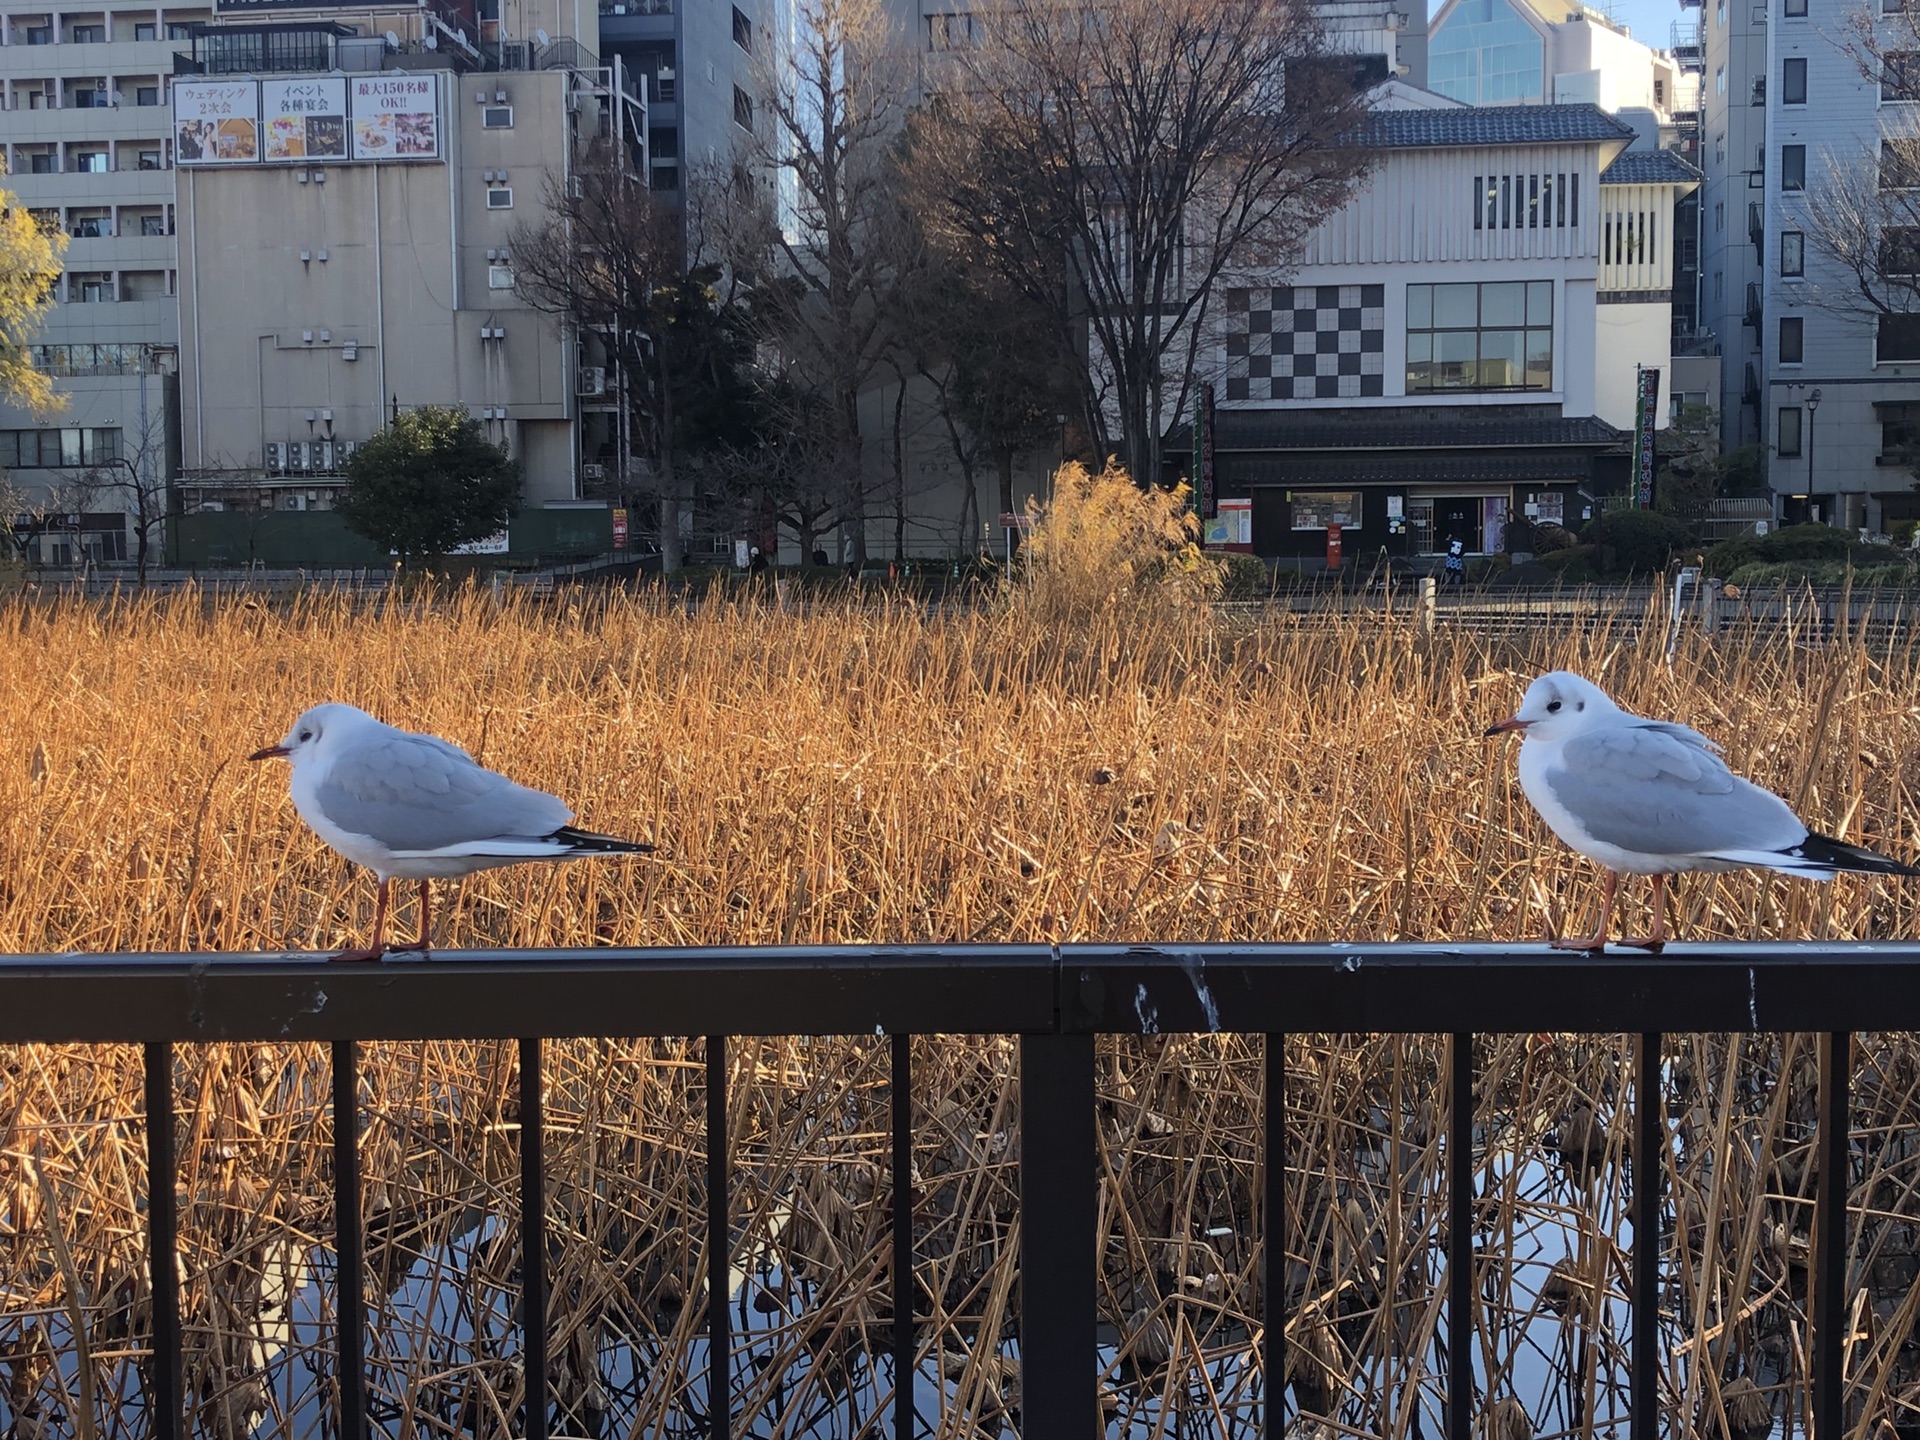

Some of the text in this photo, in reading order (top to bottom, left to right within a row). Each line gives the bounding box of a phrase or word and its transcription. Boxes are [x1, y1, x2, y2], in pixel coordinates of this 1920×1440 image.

[185, 87, 247, 101] ウェディング
[284, 85, 325, 98] イベント
[358, 81, 429, 96] 最大150名様
[199, 101, 232, 115] 2次会
[280, 98, 329, 113] 各種宴会
[380, 97, 407, 109] OK!!
